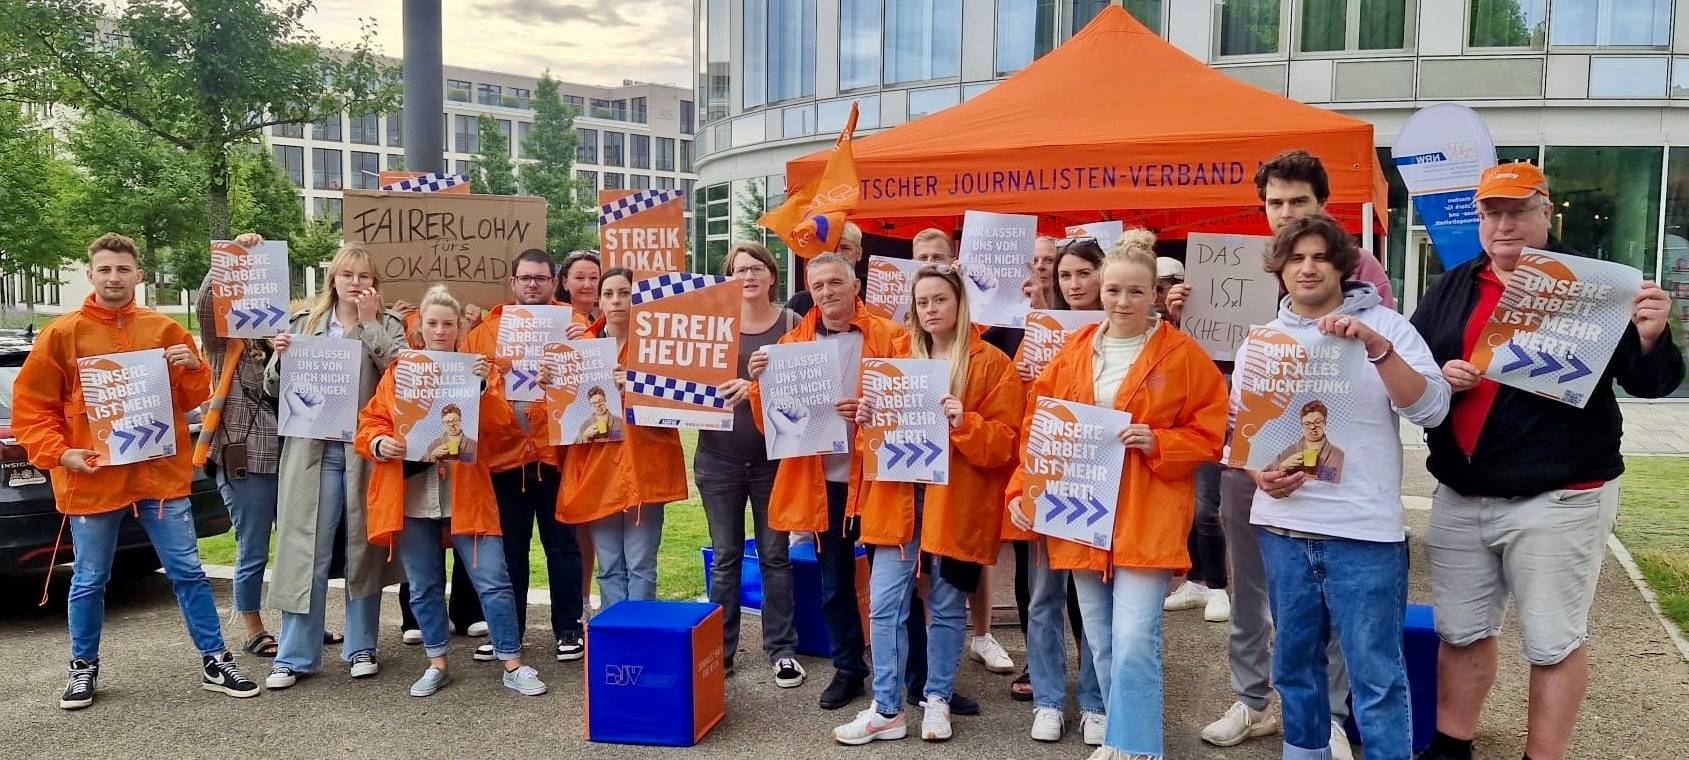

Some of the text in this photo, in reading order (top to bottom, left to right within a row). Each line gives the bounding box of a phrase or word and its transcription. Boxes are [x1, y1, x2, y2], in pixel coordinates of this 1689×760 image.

[861, 175, 938, 200] TSCHER
[948, 161, 1244, 195] JOURNALISTEN-VERBAND
[604, 227, 680, 250] STREIK
[986, 226, 1026, 239] LASSEN
[431, 239, 470, 256] fürs
[973, 239, 1018, 251] UNS VON
[220, 254, 271, 267] UNSERE
[966, 253, 1026, 265] EUCH NICHT
[1196, 243, 1245, 266] DAS
[223, 269, 267, 282] ARBEIT
[384, 254, 508, 281] OKALRAD
[879, 270, 904, 280] OHNE
[219, 282, 279, 297] IST MEHR
[879, 282, 895, 292] IST
[1524, 275, 1613, 300] UNSERE
[872, 293, 912, 305] MUCKEF
[1517, 295, 1595, 317] ARBEIT
[508, 317, 554, 328] UNSERE
[635, 311, 735, 342] STREIK
[1501, 310, 1602, 343] IST MEHR
[508, 330, 551, 343] ARBEIT
[502, 345, 522, 357] IST
[1263, 343, 1341, 359] OHNE UNS
[1511, 329, 1578, 361] WERT!
[289, 347, 351, 360] WIR LASSEN
[553, 347, 602, 363] OHNE UNS
[638, 338, 729, 369] HEUTE
[787, 353, 830, 369] LASSEN
[298, 360, 343, 371] UNS VON
[409, 361, 465, 373] OHNE UNS
[511, 359, 538, 371] WER
[557, 363, 574, 374] IST
[1265, 360, 1340, 376] IST ALLES
[92, 364, 147, 386] UNSERE
[290, 372, 351, 383] EUCH NICHT
[411, 375, 466, 386] IST ALLES
[775, 367, 823, 383] UNS VON
[872, 375, 929, 391] UNSERE
[97, 380, 147, 402] ARBEIT
[770, 380, 832, 398] EUCH NICHT
[1253, 377, 1350, 394] MUCKEFUNK!
[94, 394, 162, 419] IST MEHR
[875, 393, 925, 409] ARBEIT
[111, 411, 155, 430] WERT!
[872, 410, 937, 427] IST MEHR
[883, 429, 927, 445] WERT!
[1042, 419, 1105, 441] UNSERE
[1040, 438, 1098, 460] ARBEIT
[1, 461, 31, 469] INSIG
[1034, 458, 1108, 482] IST MEHR
[1044, 479, 1094, 501] WERT!
